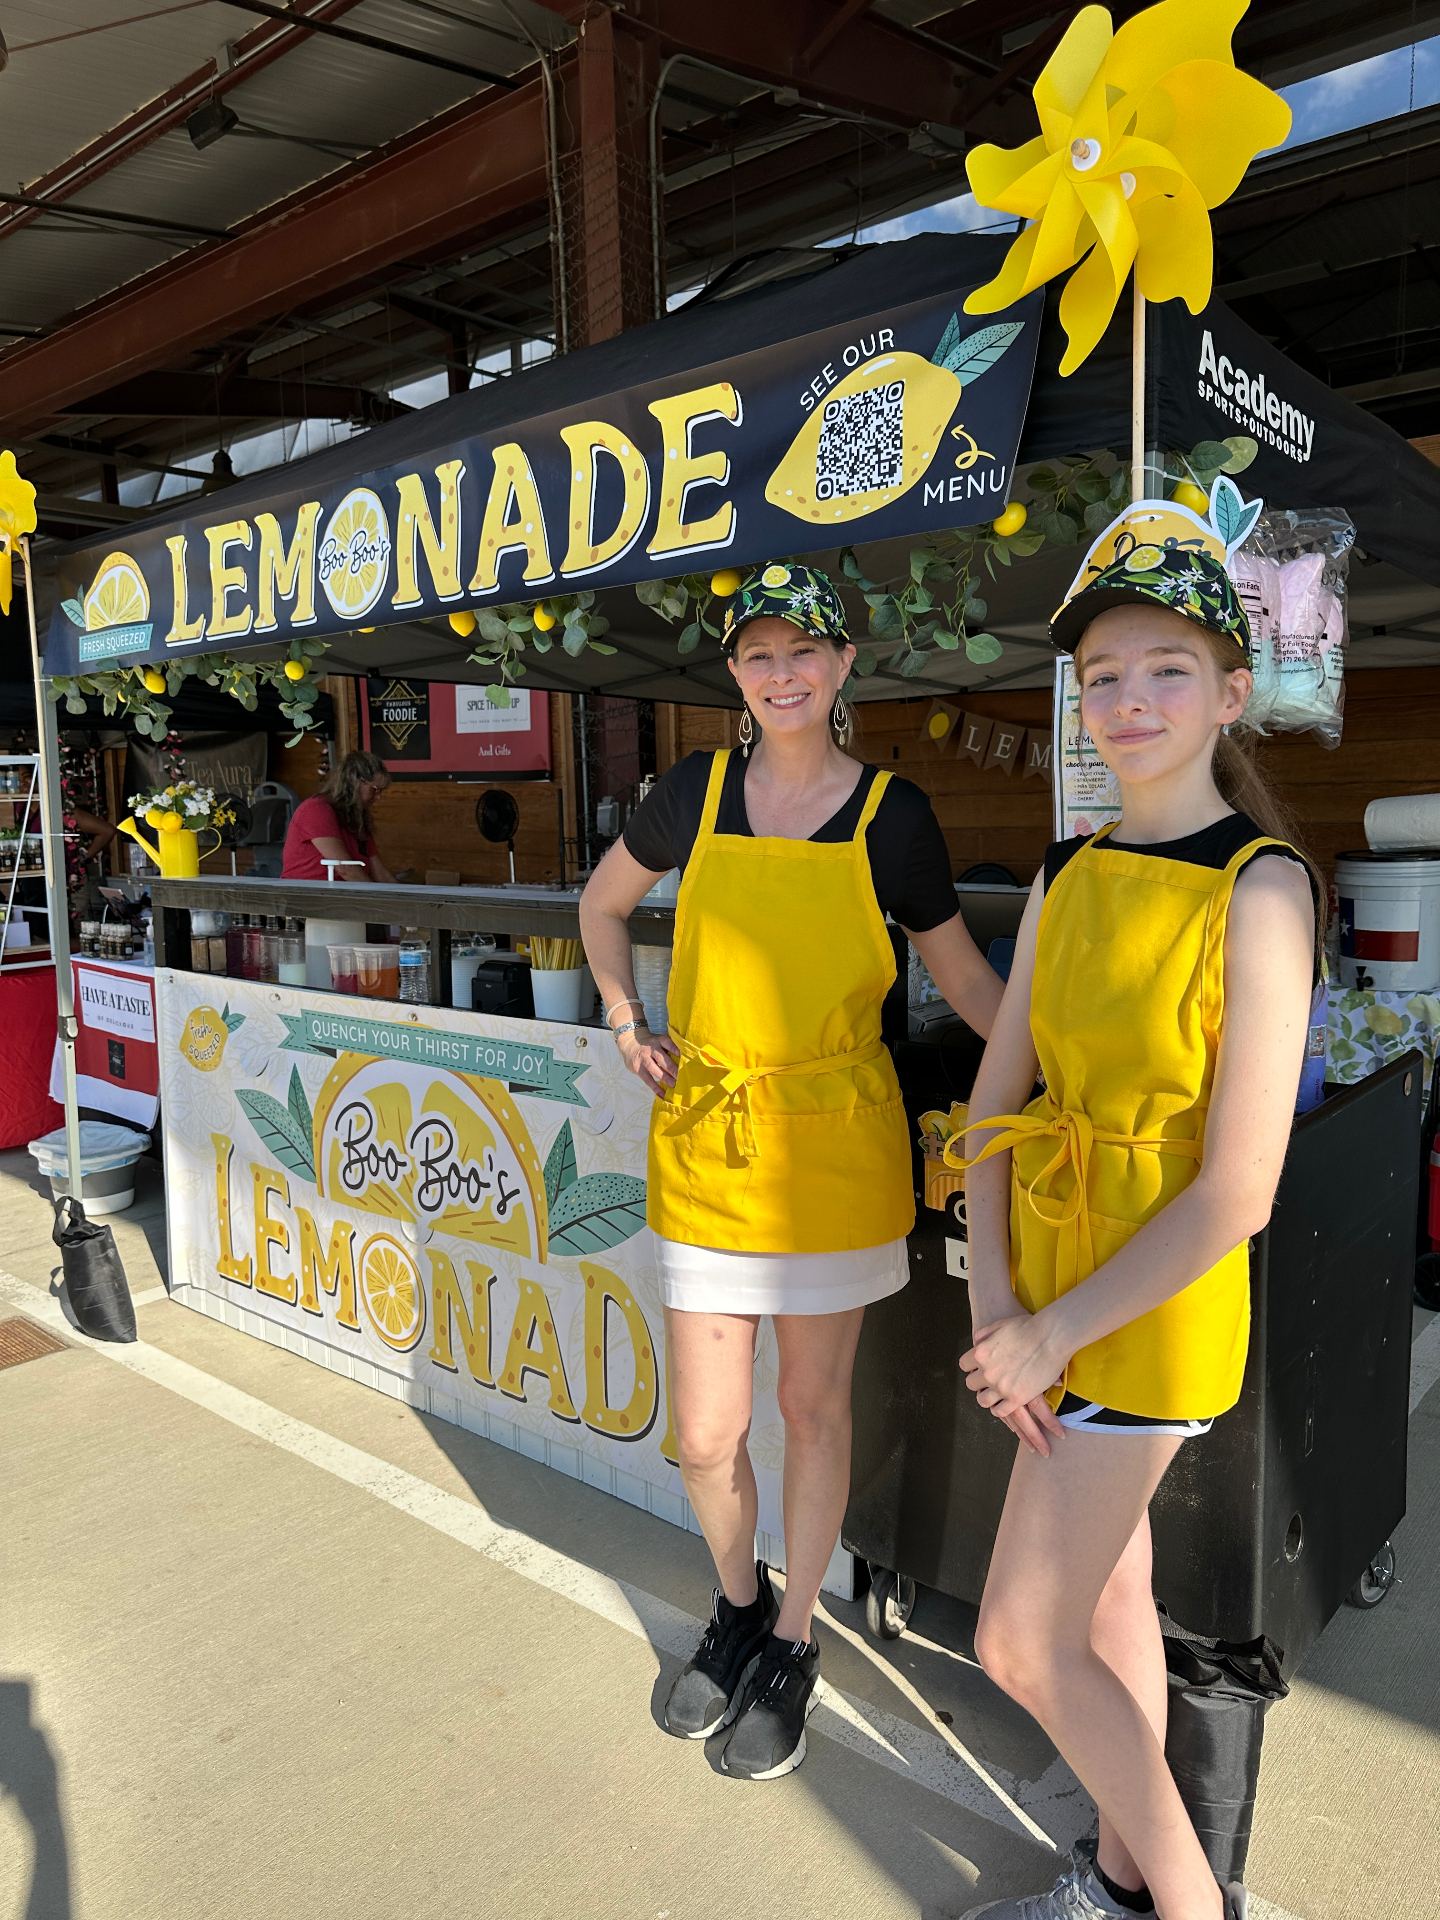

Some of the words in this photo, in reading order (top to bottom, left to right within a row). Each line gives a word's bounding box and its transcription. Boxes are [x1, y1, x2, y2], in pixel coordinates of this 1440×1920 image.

[800, 363, 838, 411] SEE
[842, 328, 895, 367] OUR
[1198, 330, 1315, 462] Academy
[1197, 379, 1303, 464] SPORTS+OUTDOORS
[923, 465, 1006, 507] MENU
[165, 382, 744, 647] LEMONADE
[320, 538, 348, 580] Boo
[349, 530, 390, 574] Boo's
[83, 641, 105, 654] FRESH
[106, 631, 146, 651] SQUEEZED
[383, 707, 417, 721] FOODIE
[467, 700, 484, 712] SPICE
[511, 698, 520, 709] UP
[478, 746, 493, 757] And
[495, 744, 511, 757] Gifts
[82, 986, 108, 1006] HAVE
[109, 993, 115, 1009] A
[115, 994, 151, 1017] TASTE
[189, 1033, 221, 1061] SQUEEZED
[190, 1014, 213, 1045] fresh
[312, 1019, 367, 1044] QUENCH
[371, 1030, 411, 1051] YOUR
[415, 1036, 470, 1061] THIRST
[476, 1046, 507, 1069] FOR
[512, 1053, 544, 1075] JOY
[335, 1101, 408, 1190] Boo
[410, 1119, 520, 1216] Boo's
[210, 1132, 680, 1467] LEMONAD
